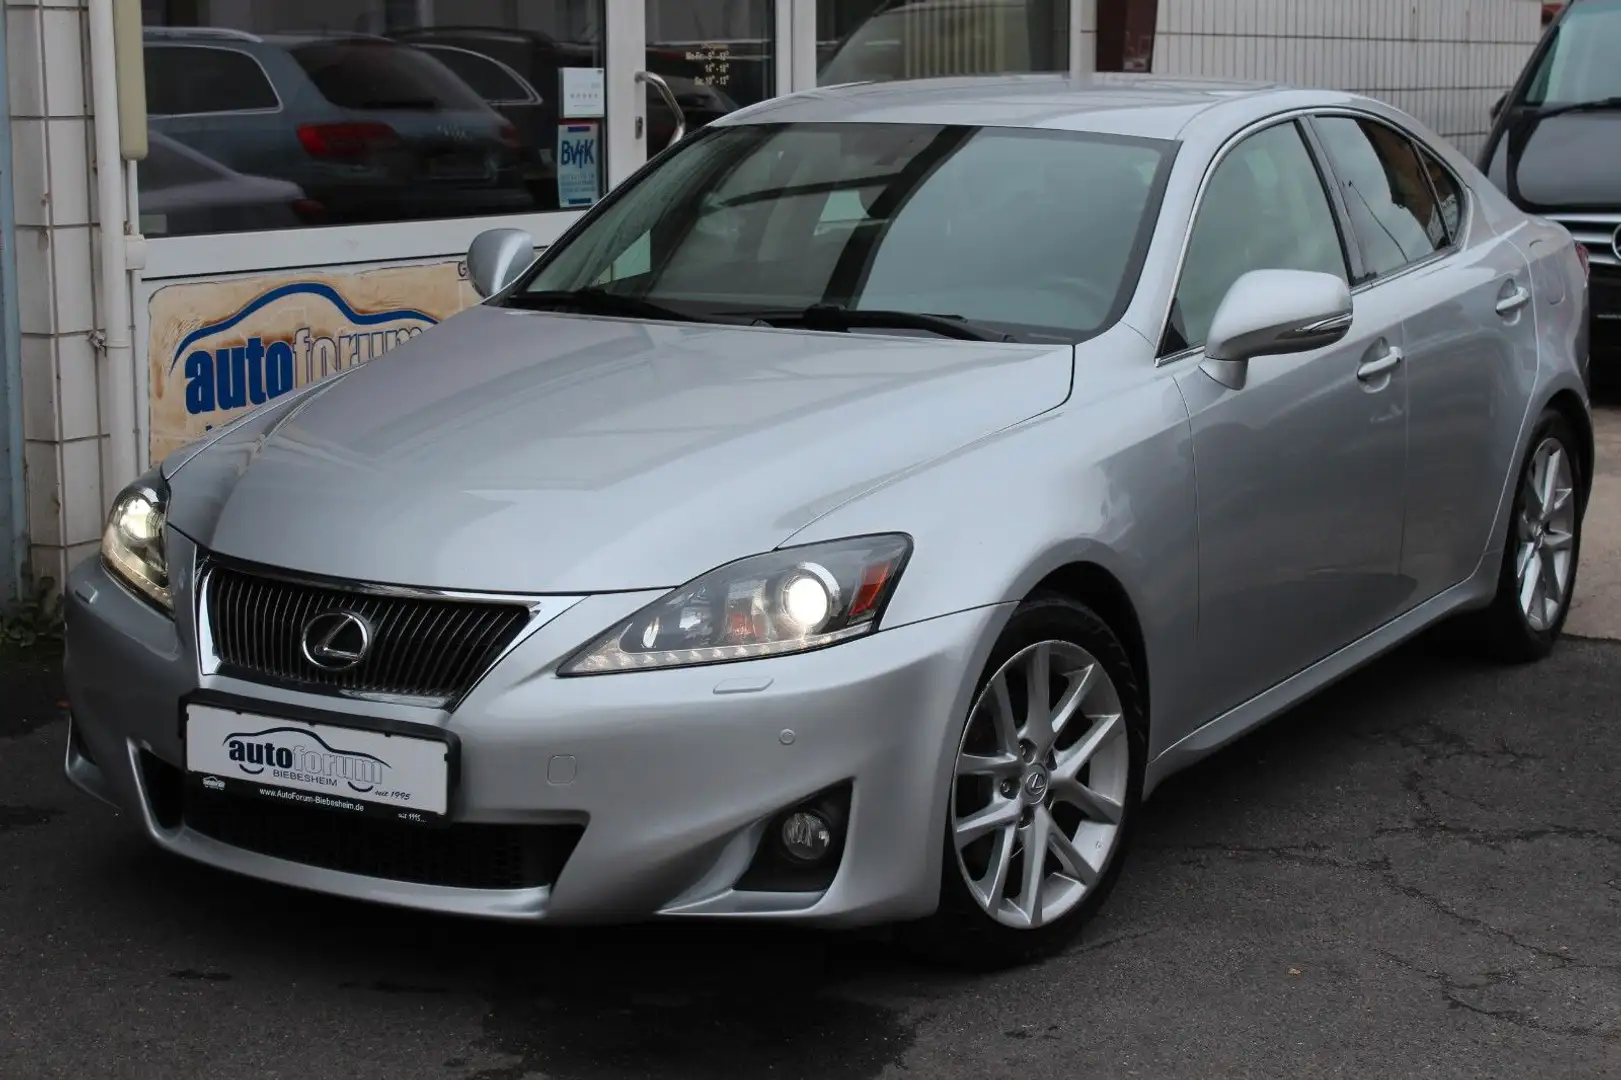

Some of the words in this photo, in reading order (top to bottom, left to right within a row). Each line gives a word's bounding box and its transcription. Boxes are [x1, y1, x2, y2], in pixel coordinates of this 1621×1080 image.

[184, 327, 424, 415] autofor
[228, 740, 383, 785] autoforum
[273, 769, 338, 787] BIEBESHEIM
[259, 788, 365, 811] www.AutoForum-Biebesheim.de
[391, 791, 411, 800] 1995
